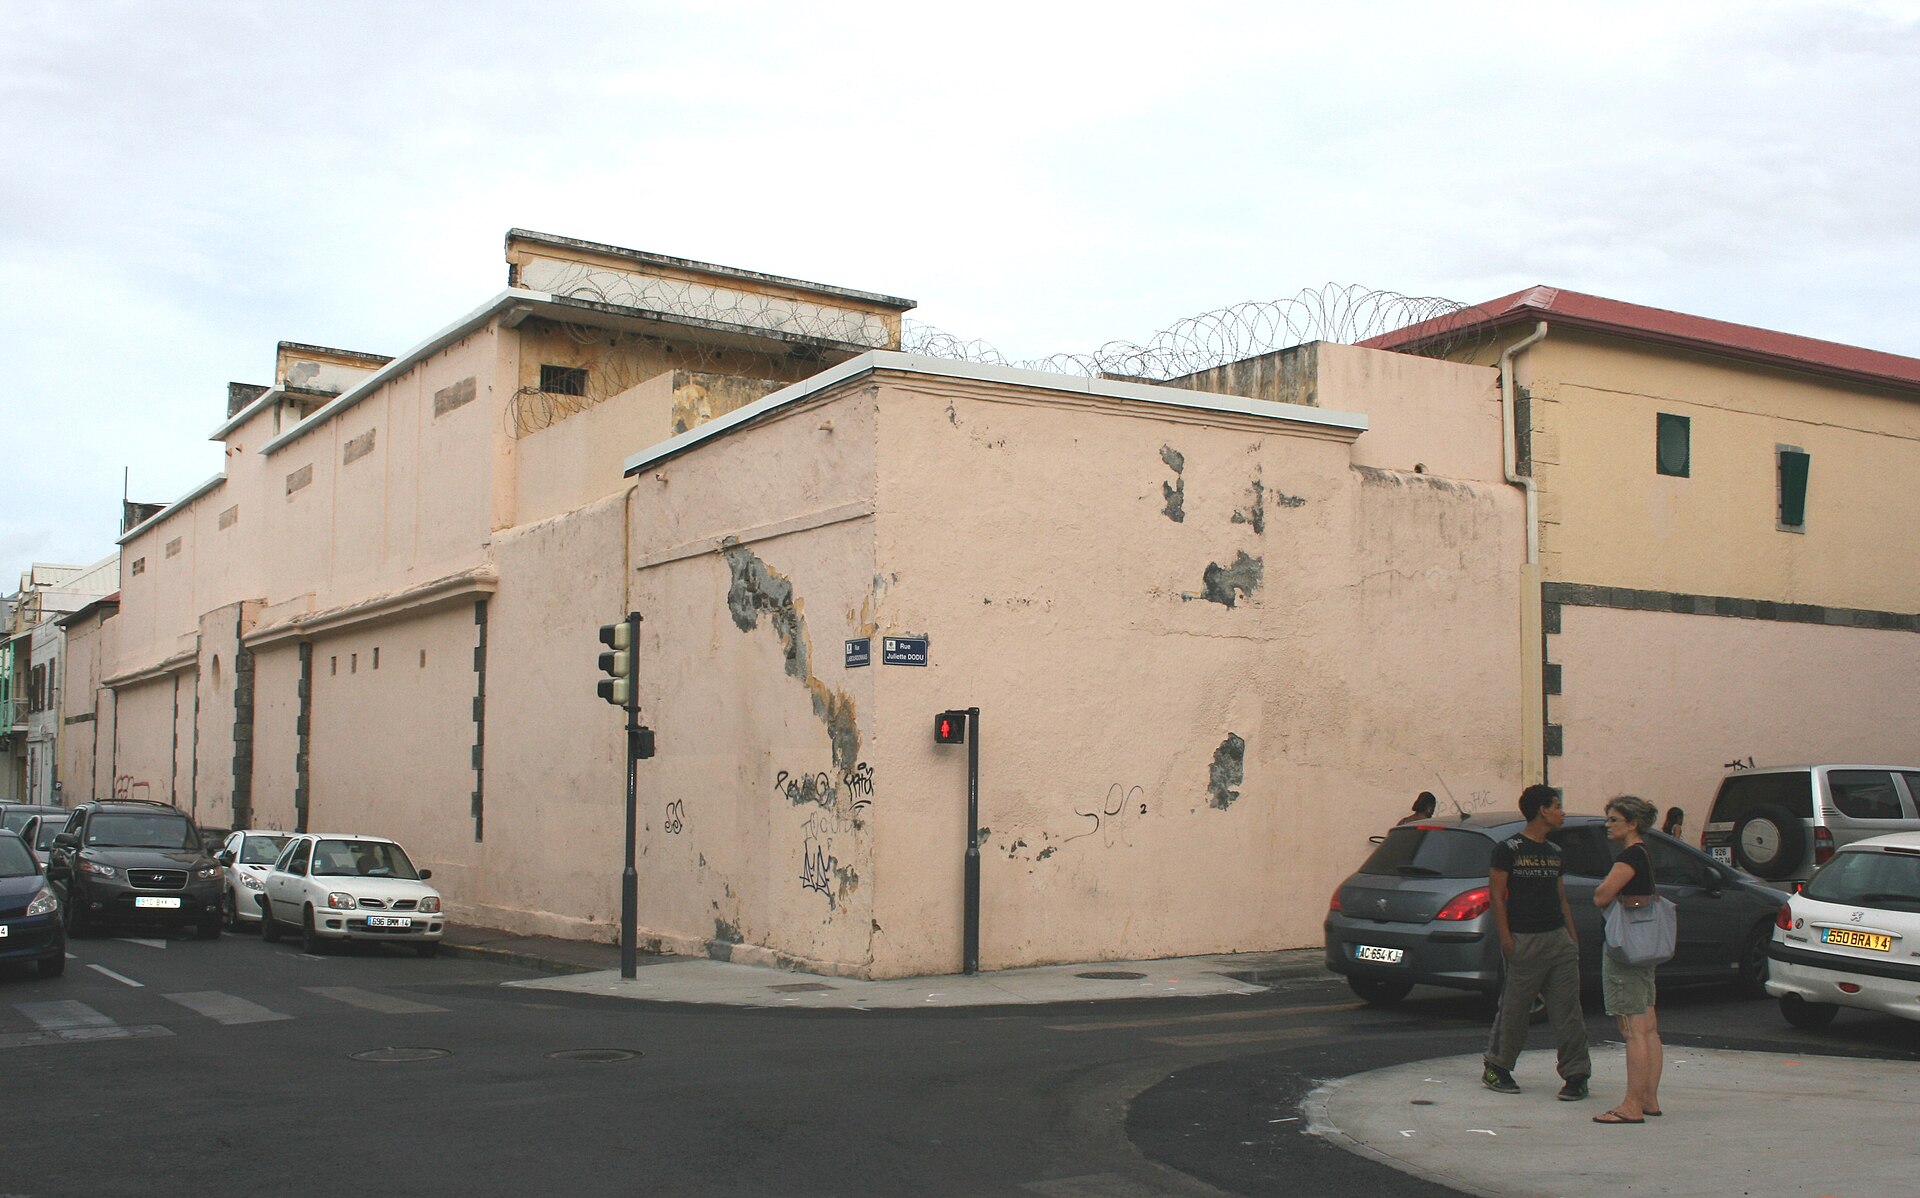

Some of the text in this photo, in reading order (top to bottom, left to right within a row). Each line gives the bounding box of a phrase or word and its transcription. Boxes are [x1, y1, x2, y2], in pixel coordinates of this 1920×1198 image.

[907, 653, 924, 661] DODU
[1828, 930, 1850, 944] 550
[1850, 932, 1871, 947] BRA
